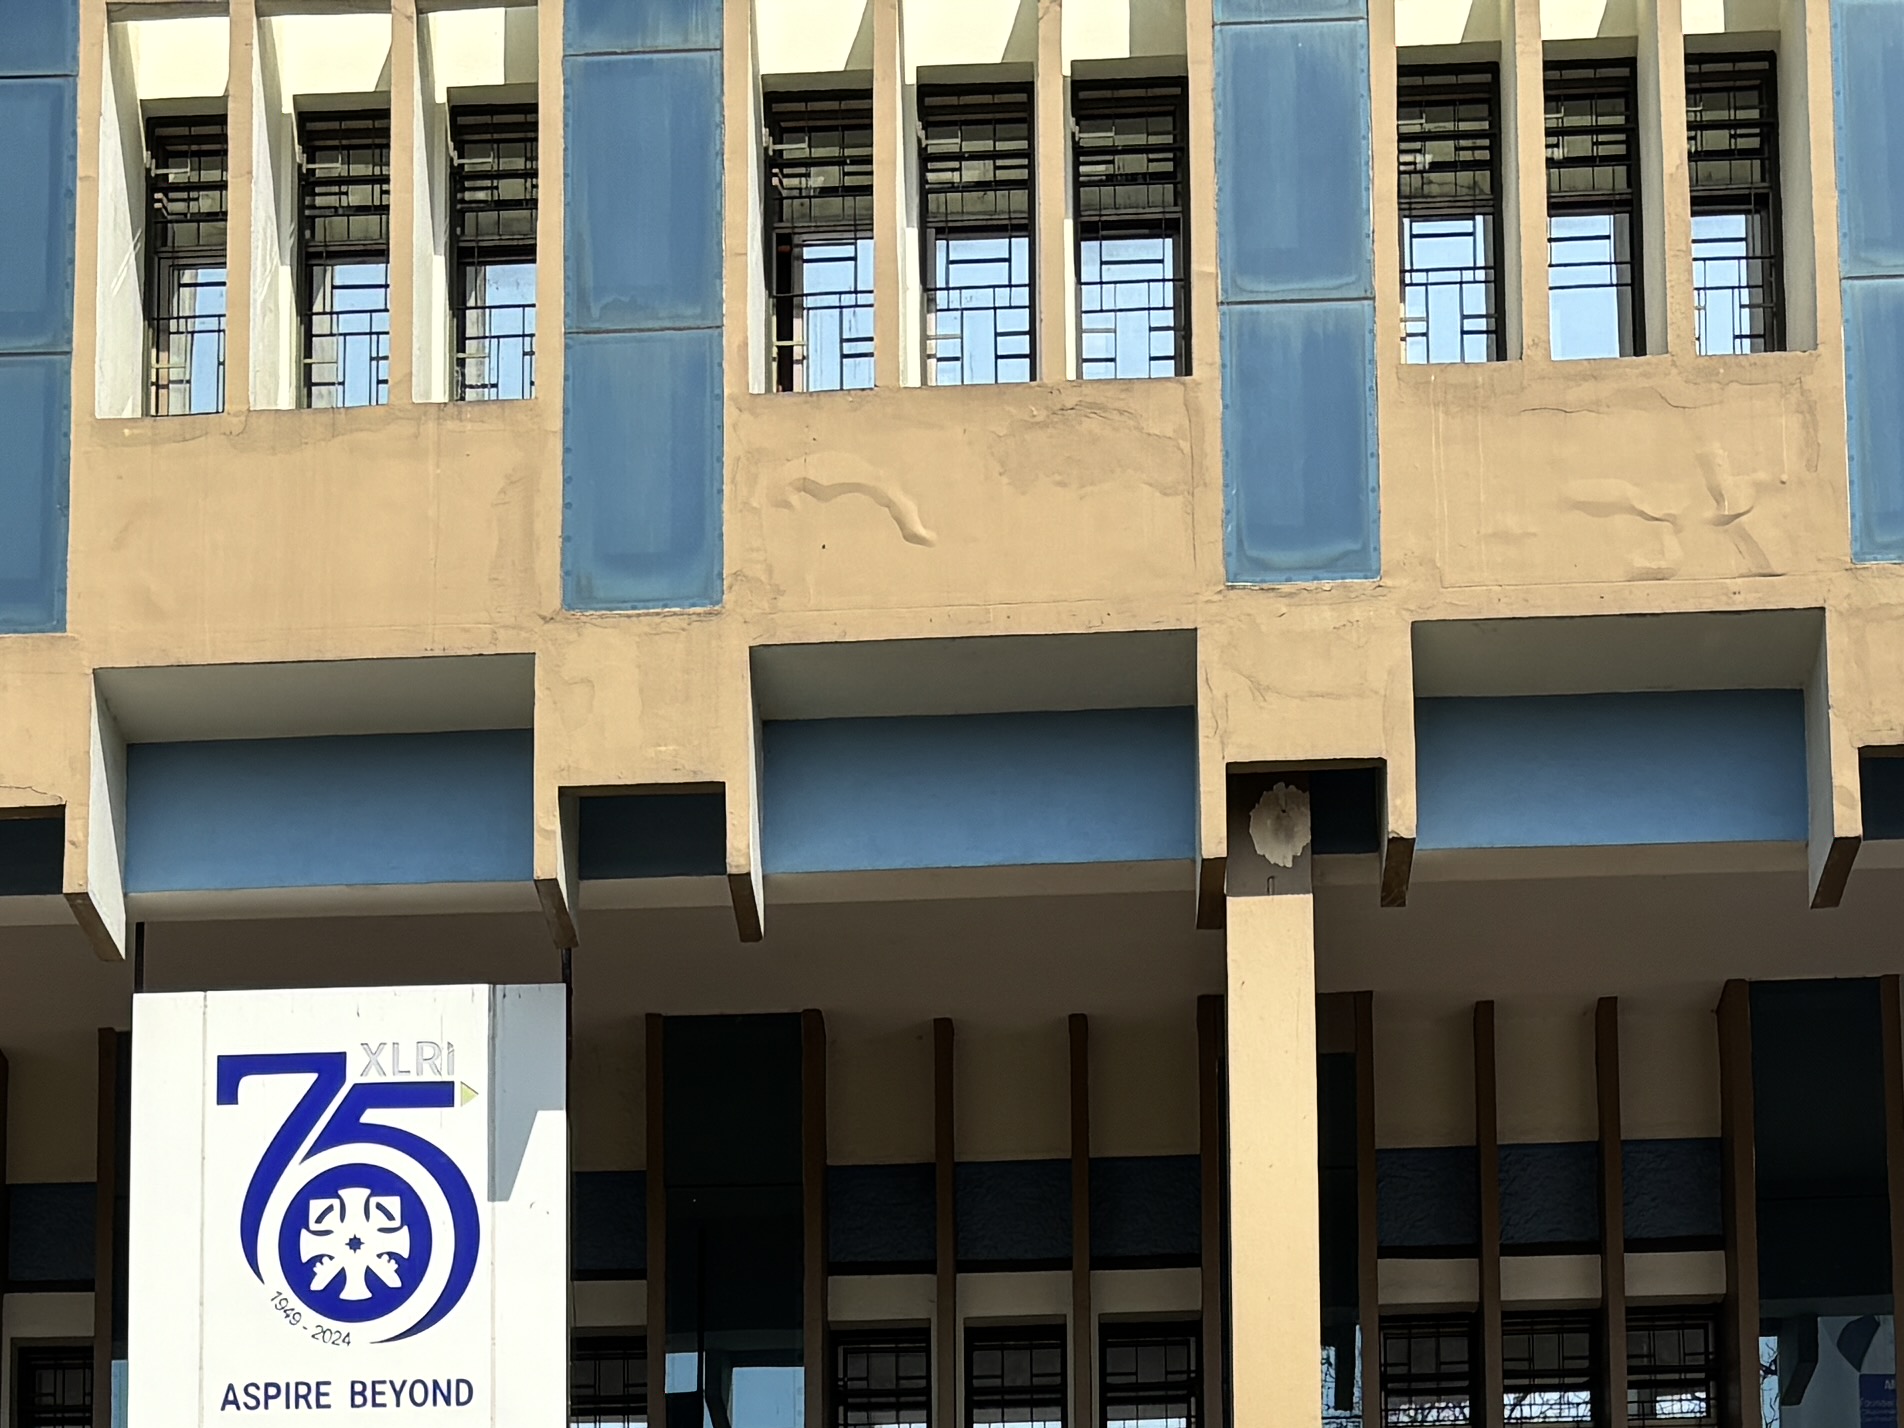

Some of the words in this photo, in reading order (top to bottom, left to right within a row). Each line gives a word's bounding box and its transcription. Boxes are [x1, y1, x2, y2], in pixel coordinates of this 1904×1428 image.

[270, 1290, 302, 1326] 1949
[311, 1324, 352, 1347] 2024
[220, 1379, 333, 1412] ASPIRE
[349, 1377, 475, 1410] BEYOND
